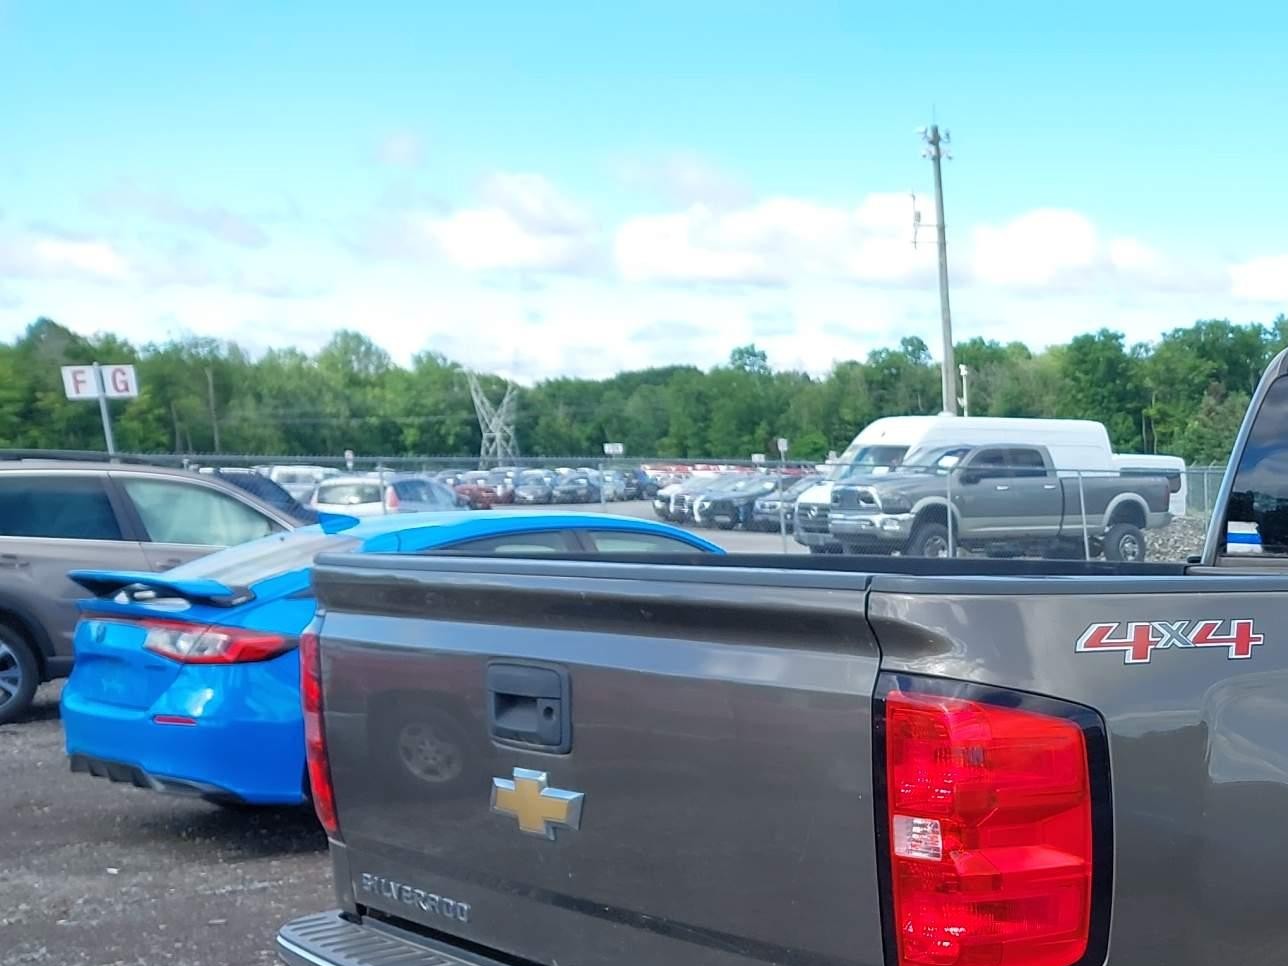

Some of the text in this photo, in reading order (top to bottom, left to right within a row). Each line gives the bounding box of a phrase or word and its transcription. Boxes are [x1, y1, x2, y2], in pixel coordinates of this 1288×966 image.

[71, 370, 87, 394] F
[111, 368, 129, 393] G
[362, 872, 471, 922] SILVERADO
